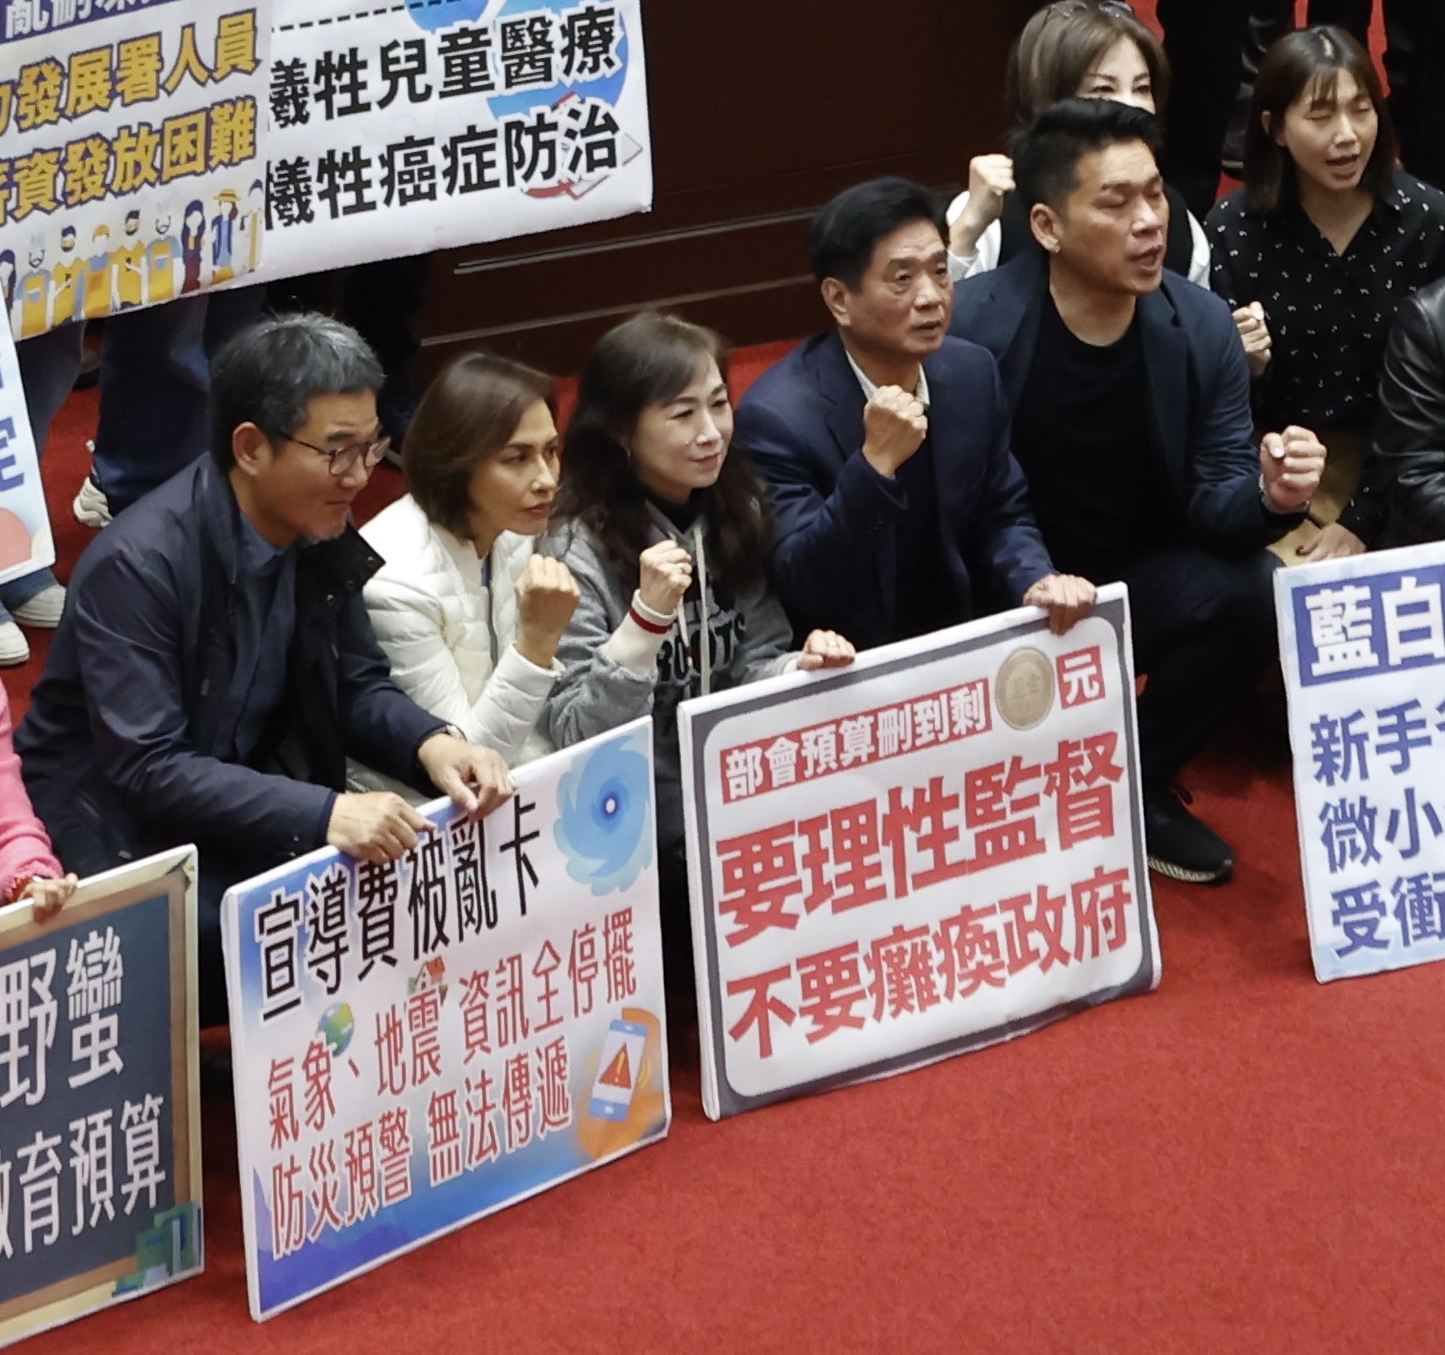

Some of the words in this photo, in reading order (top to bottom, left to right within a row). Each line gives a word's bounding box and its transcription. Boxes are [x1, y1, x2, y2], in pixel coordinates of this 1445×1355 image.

[725, 681, 986, 801] 部會預算刪到剩
[1063, 657, 1100, 703] 元
[258, 794, 541, 1021] 宣導費被亂卡
[716, 731, 1126, 948] 要理性監督
[459, 906, 637, 1064] 資訊全停擺
[726, 865, 1132, 1059] 不要癱瘓政府
[271, 1110, 412, 1257] 防災預警
[428, 1036, 571, 1186] 無法傳遞
